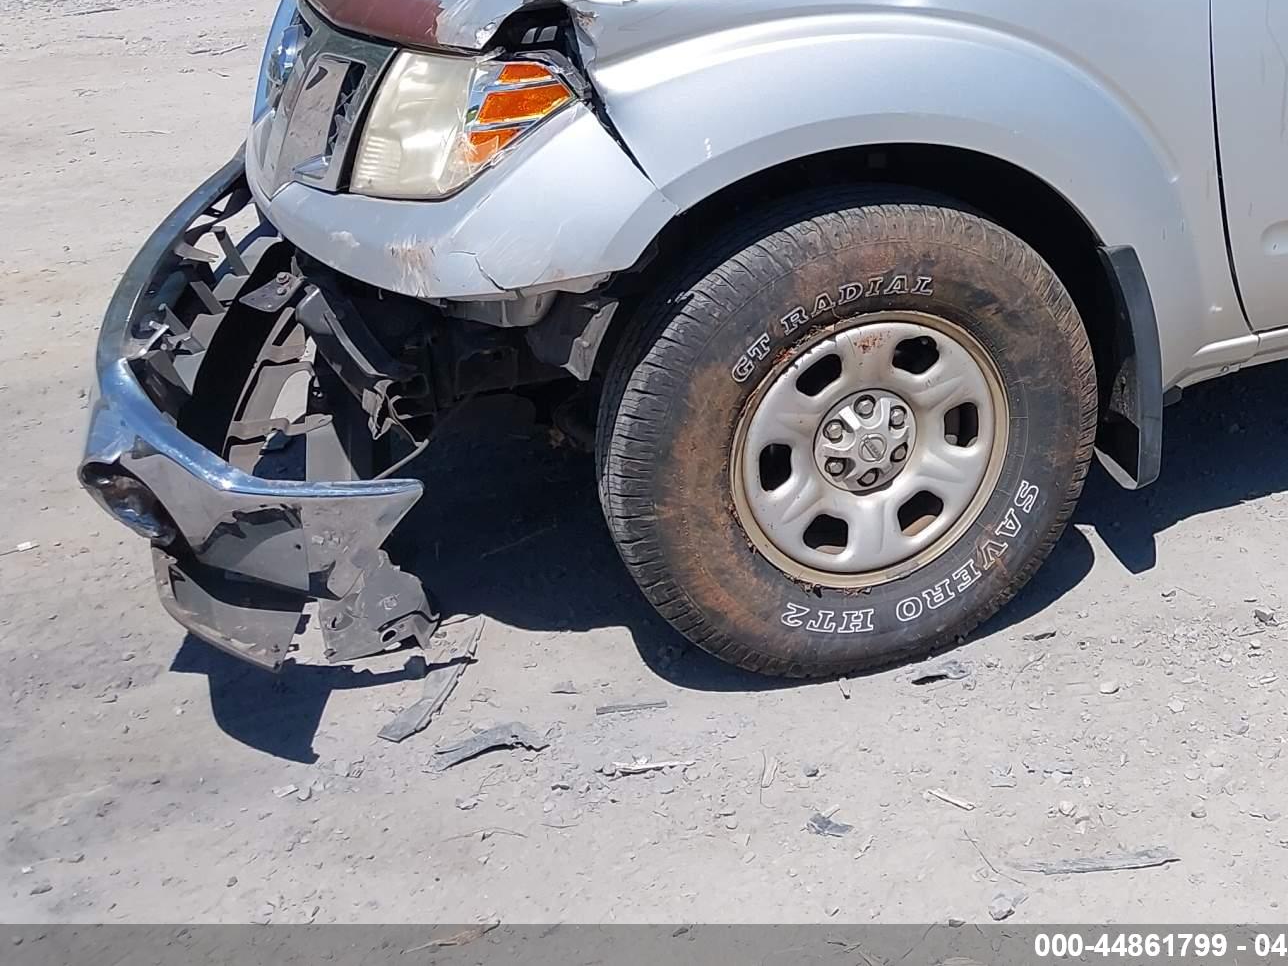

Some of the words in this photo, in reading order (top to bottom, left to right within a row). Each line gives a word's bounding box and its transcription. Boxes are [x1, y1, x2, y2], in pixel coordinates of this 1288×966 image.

[731, 332, 771, 384] GT
[780, 274, 935, 336] RADIAL
[895, 479, 1040, 623] SAVERO
[780, 601, 875, 635] HT2
